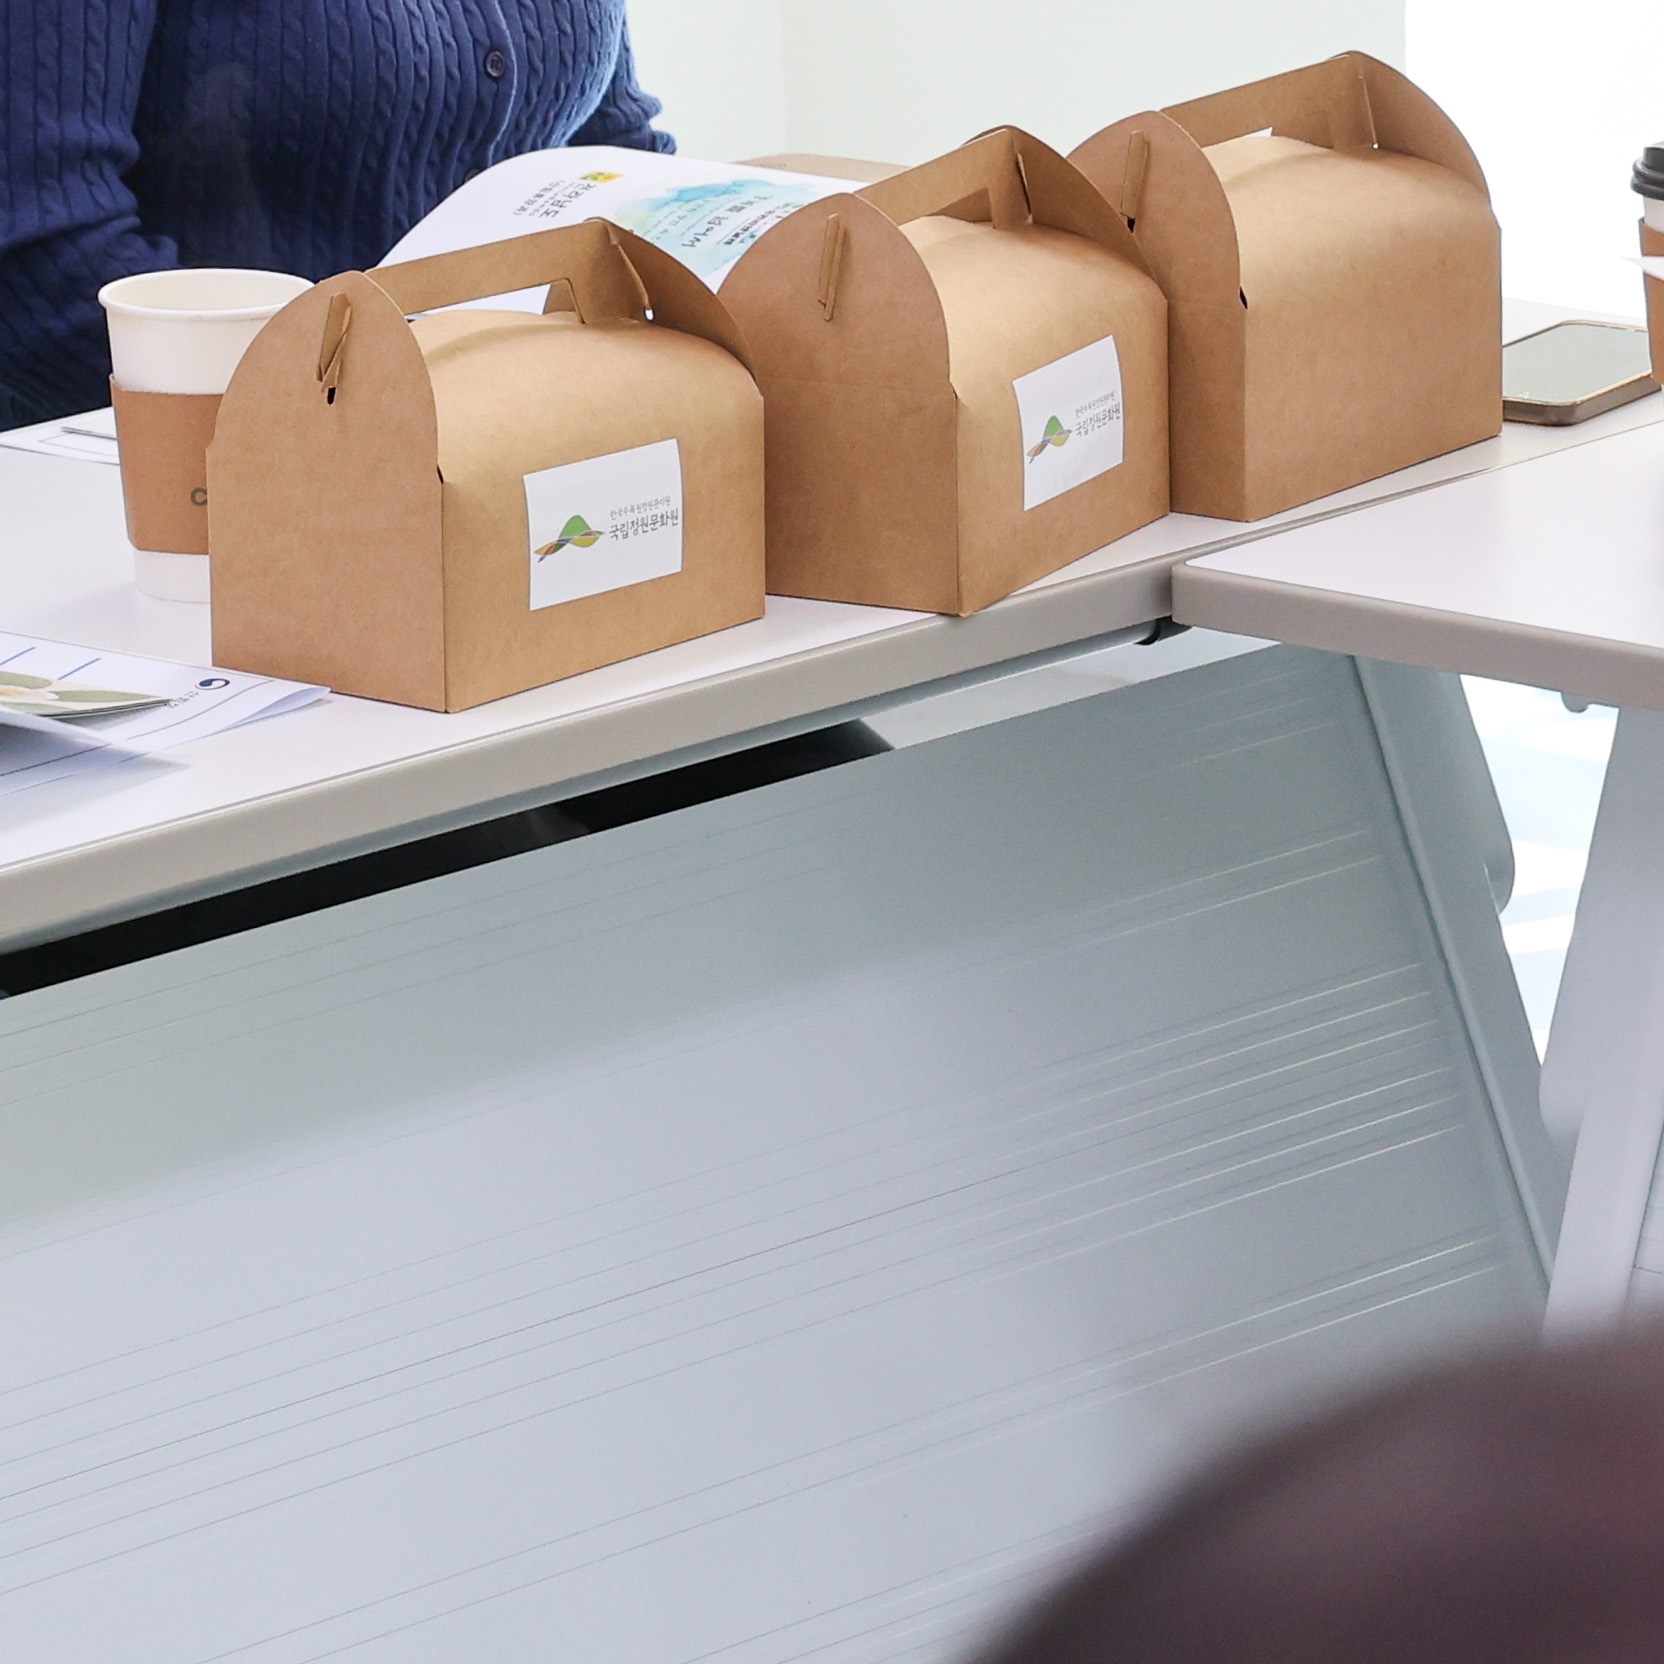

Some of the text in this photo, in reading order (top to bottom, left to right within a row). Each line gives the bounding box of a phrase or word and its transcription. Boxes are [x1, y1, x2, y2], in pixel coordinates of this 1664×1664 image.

[539, 183, 596, 218] 전라남도
[1074, 402, 1120, 438] 국립정원문화원
[609, 508, 679, 540] 국립정원문화원
